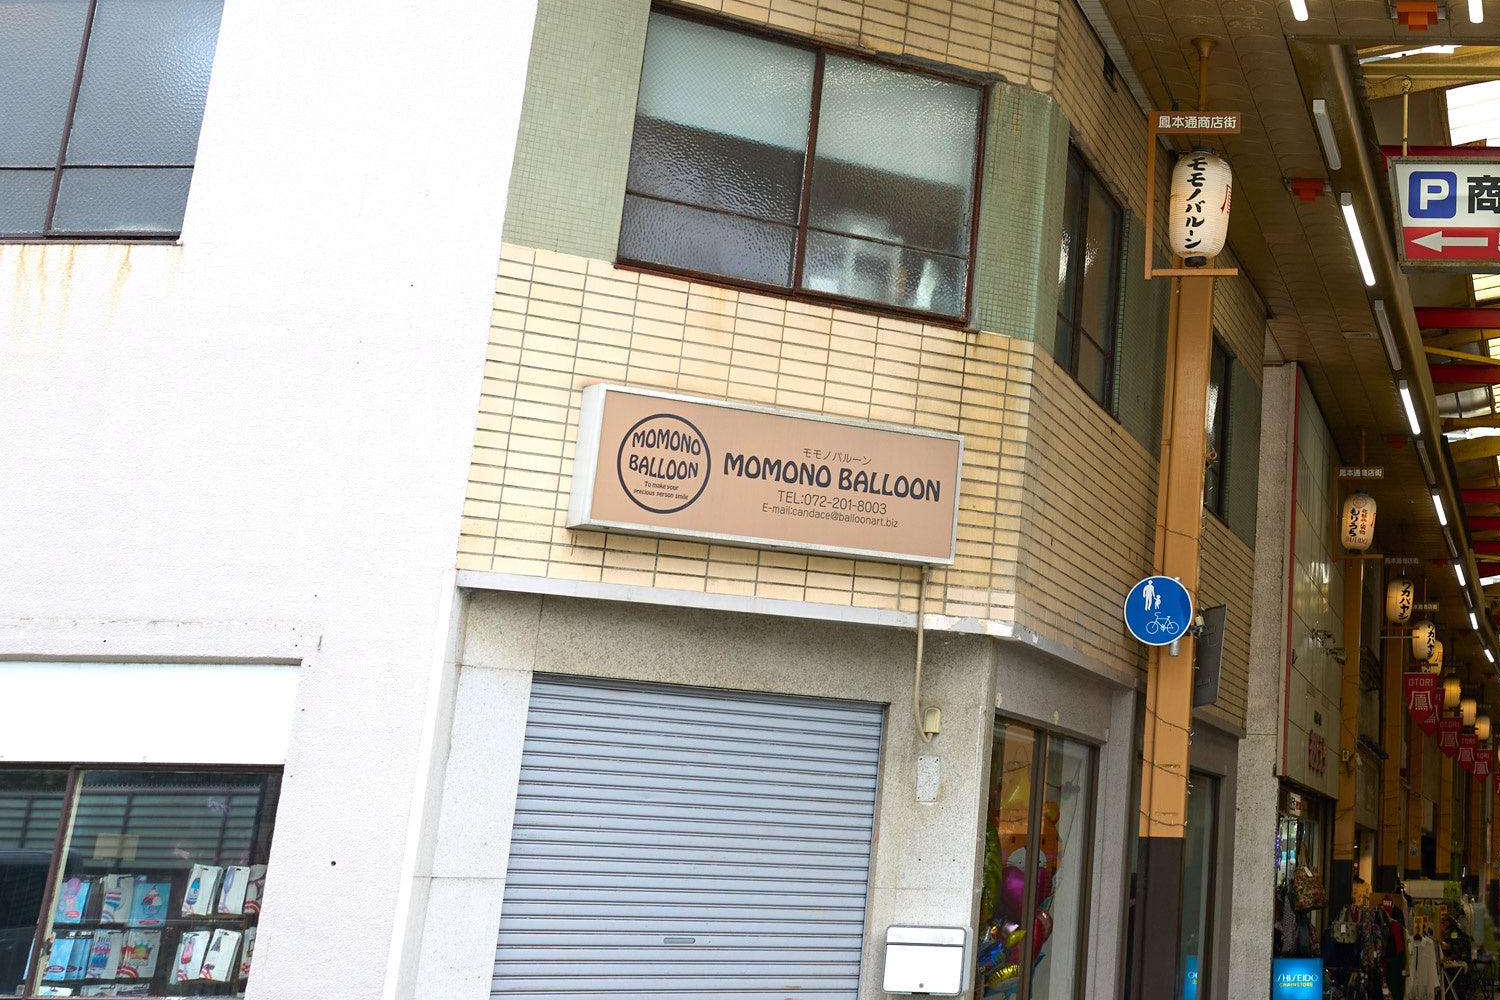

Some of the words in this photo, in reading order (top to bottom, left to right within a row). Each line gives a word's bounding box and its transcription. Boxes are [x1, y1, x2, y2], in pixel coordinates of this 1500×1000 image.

[1158, 115, 1237, 129] 鳳本通商店街
[1185, 157, 1208, 249] モモノバルーン
[1419, 179, 1449, 209] P
[632, 428, 701, 456] MOMONO
[629, 454, 698, 480] BALLOON
[723, 452, 832, 488] MOMONO
[838, 467, 941, 502] BALLOON
[633, 488, 655, 497] precious
[675, 492, 689, 500] smile
[644, 480, 652, 488] To
[652, 482, 667, 490] make
[667, 484, 679, 492] your
[777, 490, 887, 515] TEL:072-201-8003
[762, 503, 898, 528] E-mail:candace@balloonart.biz
[1408, 678, 1433, 687] OTORI
[1277, 974, 1319, 982] SHISEIDO
